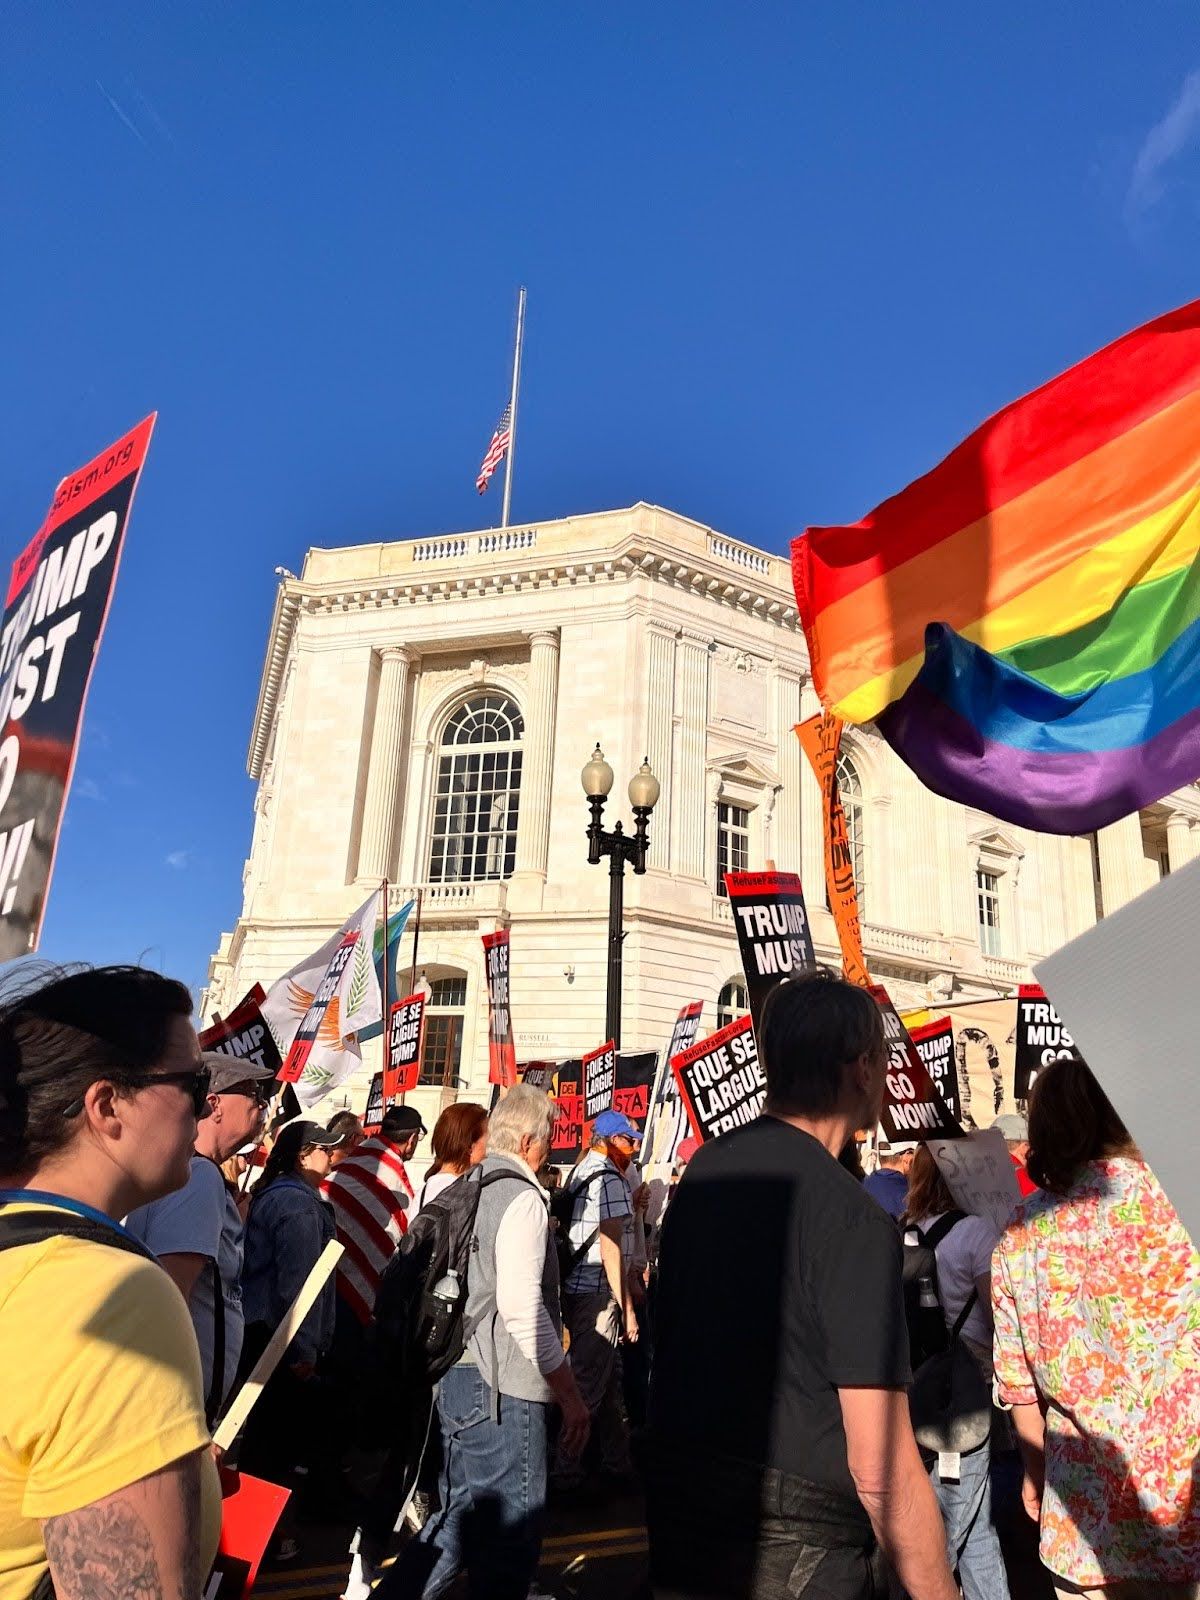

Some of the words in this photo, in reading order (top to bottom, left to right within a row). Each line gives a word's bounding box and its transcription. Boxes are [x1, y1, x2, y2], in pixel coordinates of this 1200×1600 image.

[0, 611, 81, 730] UST
[737, 904, 805, 938] TRUMP
[754, 940, 808, 975] MUST
[409, 1002, 422, 1020] SE
[1021, 1003, 1062, 1024] TRU
[216, 1024, 265, 1057] UMP
[391, 1021, 420, 1048] LAGUE
[683, 1023, 744, 1061] RefuseFascism.org
[917, 1035, 952, 1061] RUMP
[1027, 1025, 1075, 1047] MUS
[391, 1041, 417, 1066] TRUMP
[587, 1055, 603, 1081] ¡QUE
[605, 1051, 614, 1069] SE
[687, 1046, 733, 1096] ¡QUE
[731, 1031, 757, 1064] SE
[924, 1056, 949, 1079] UST
[586, 1069, 614, 1098] LARGUE
[695, 1061, 767, 1123] LARGUE
[886, 1073, 916, 1100] GO
[587, 1090, 612, 1117] TRUMP
[708, 1090, 768, 1138] TRUMP
[889, 1102, 945, 1131] NOW!
